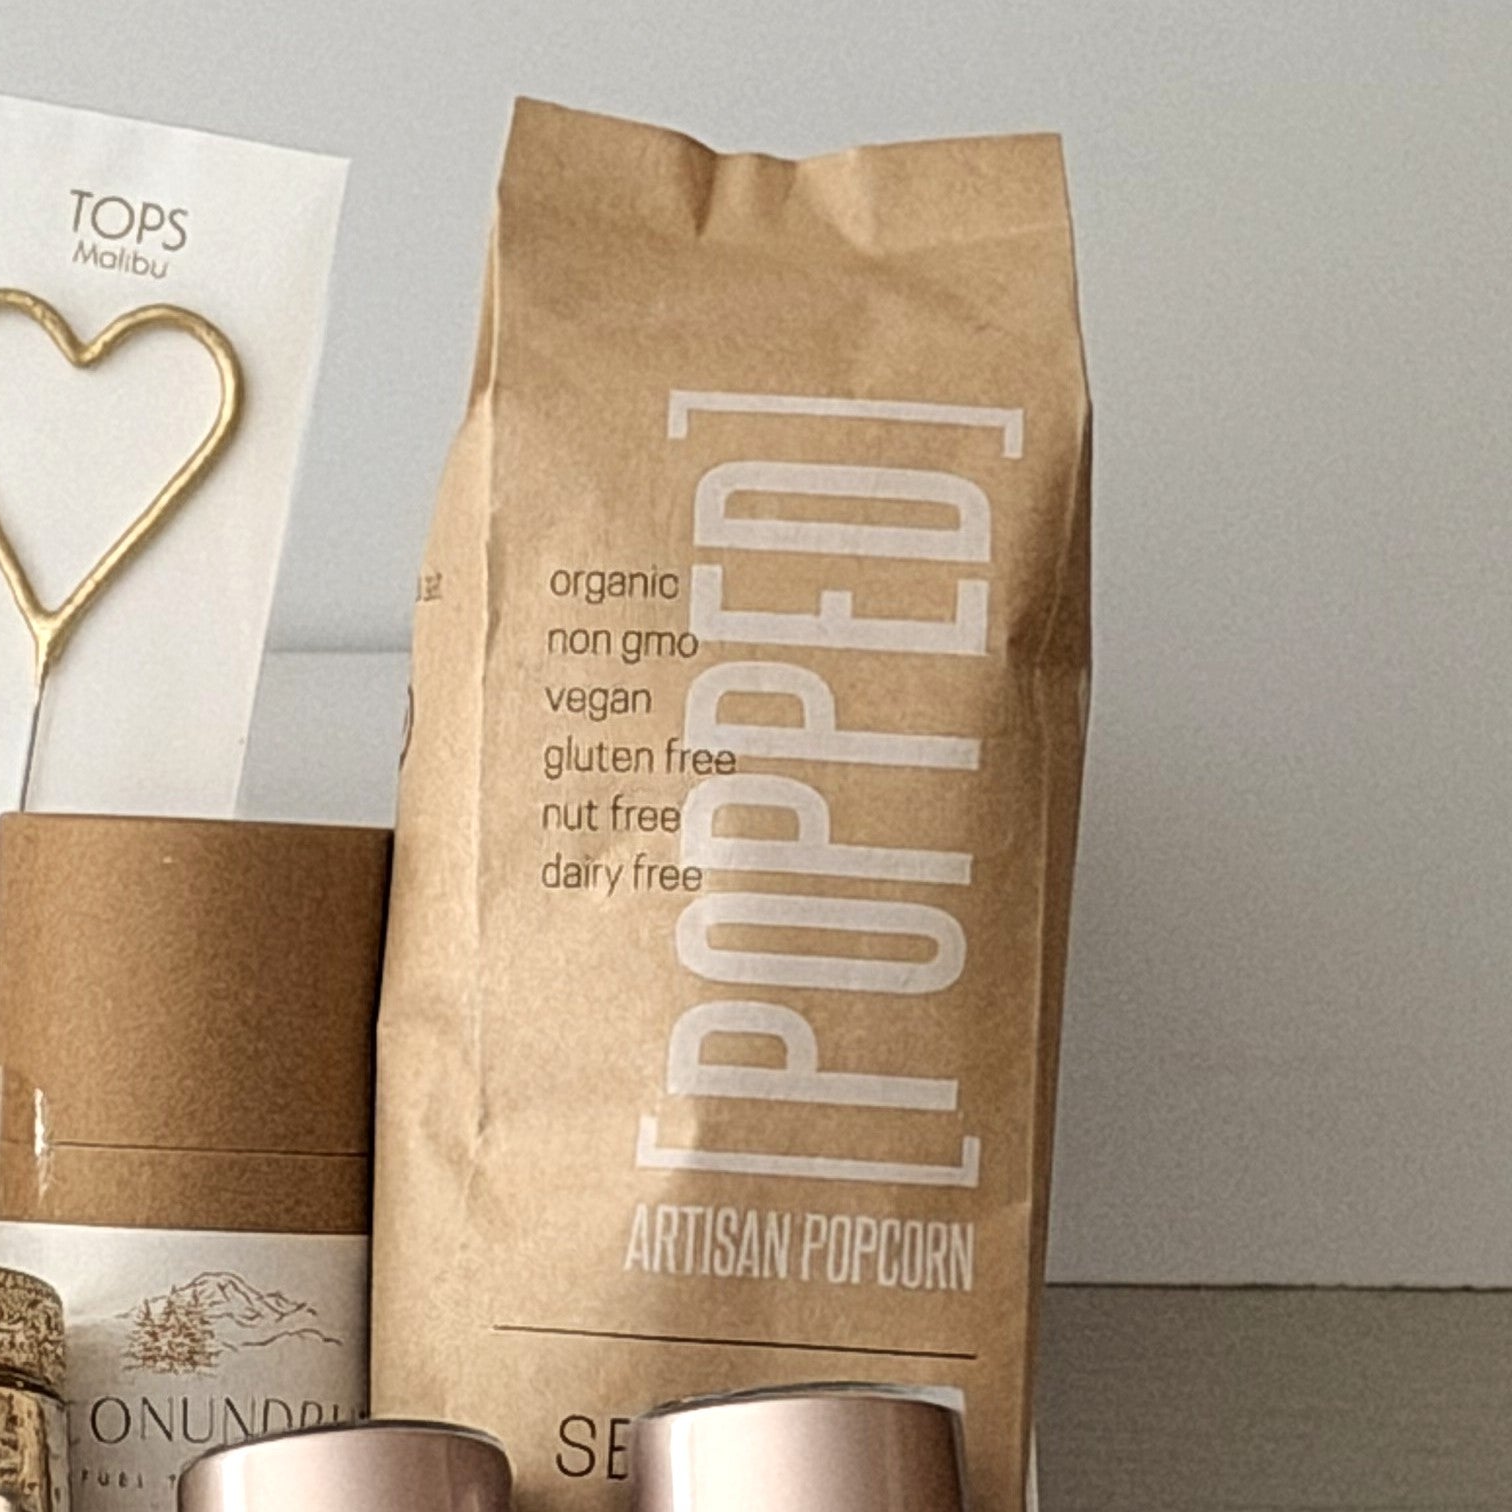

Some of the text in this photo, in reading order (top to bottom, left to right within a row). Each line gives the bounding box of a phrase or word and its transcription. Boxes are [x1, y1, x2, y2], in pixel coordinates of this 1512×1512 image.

[69, 187, 190, 254] TOPS
[71, 239, 170, 282] Malibu
[549, 566, 680, 604] organic
[547, 628, 700, 666] non gmo
[544, 684, 653, 722] vegan
[543, 736, 738, 777] gluten free
[541, 797, 681, 834] nut free
[540, 853, 704, 898] dairy free
[623, 1203, 976, 1293] ARTISAN POPCORN
